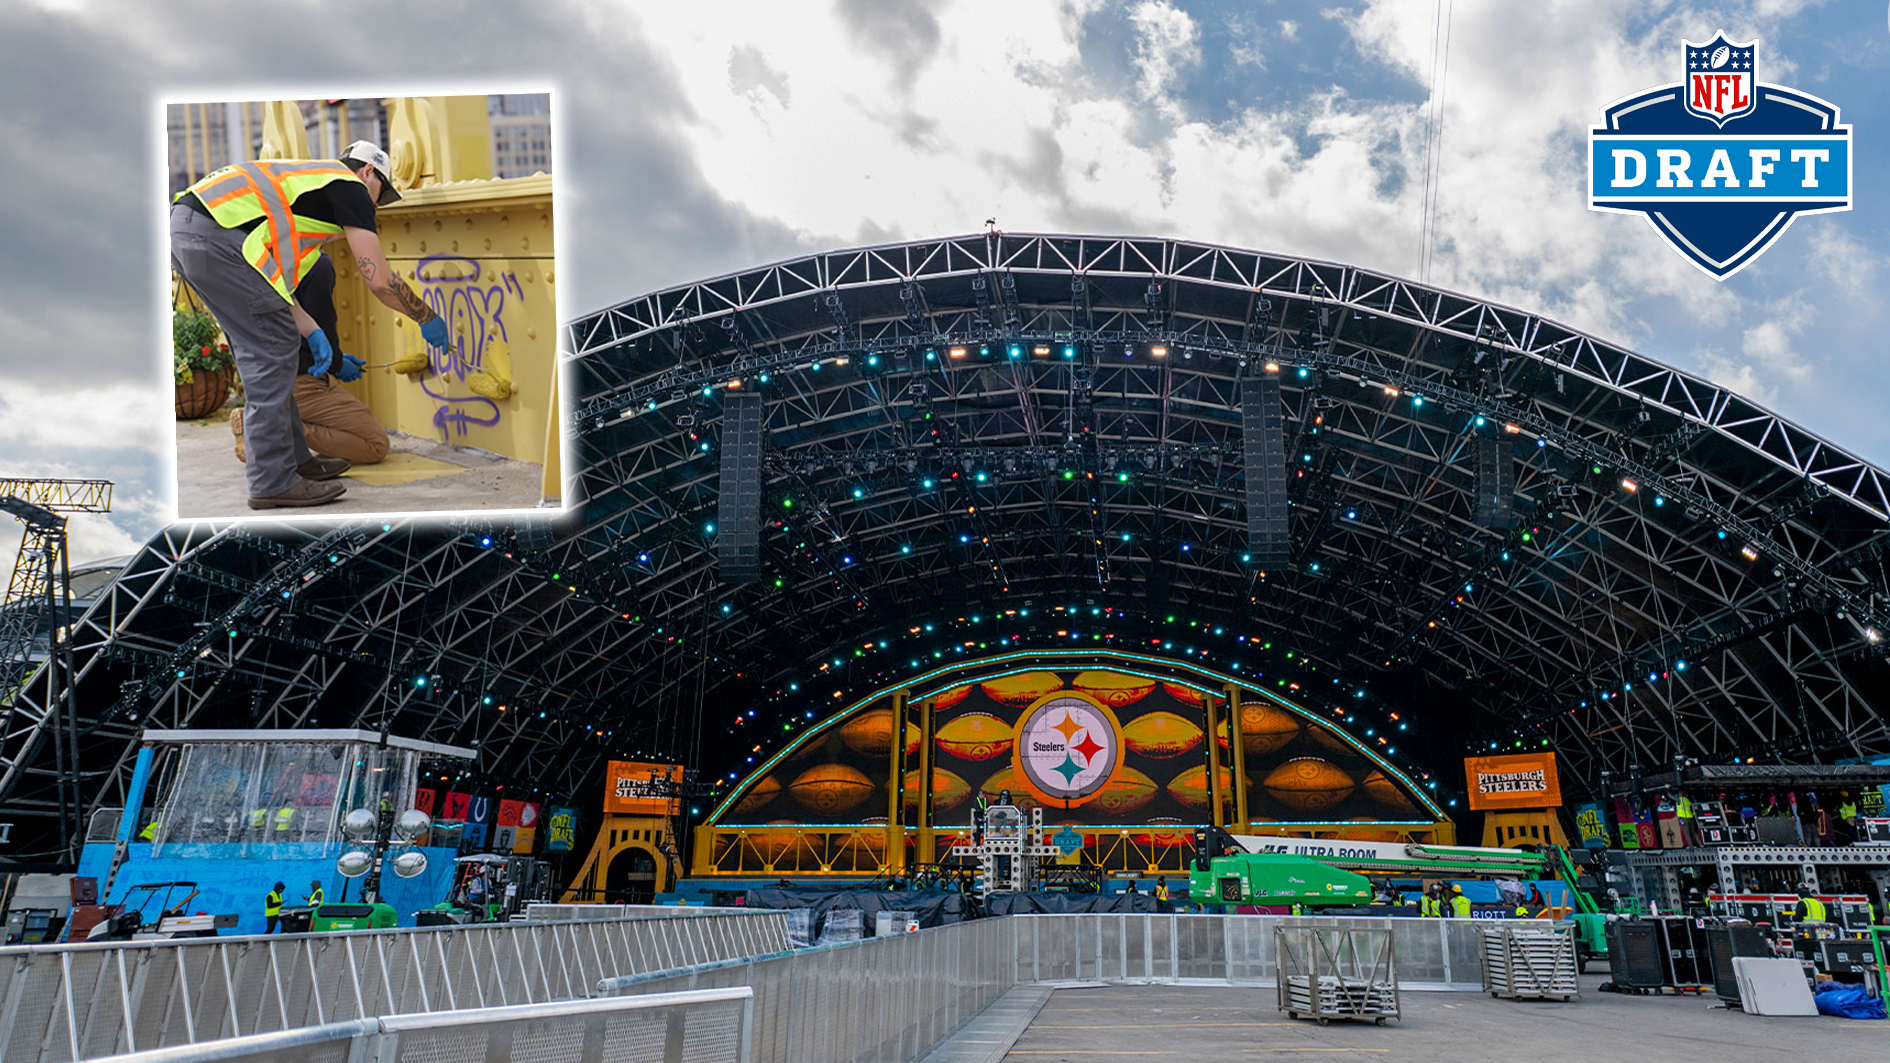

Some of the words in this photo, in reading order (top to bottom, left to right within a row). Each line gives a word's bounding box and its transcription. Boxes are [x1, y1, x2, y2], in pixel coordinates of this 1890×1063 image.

[1033, 741, 1065, 752] Steelers
[1477, 769, 1545, 785] PITTSBURGH
[1479, 780, 1547, 794] STEELERS
[1582, 809, 1600, 826] NFL
[1581, 823, 1605, 841] DRAFT
[1294, 845, 1335, 857] ULTRA
[1338, 847, 1377, 859] BOOM
[1254, 889, 1268, 897] JLG
